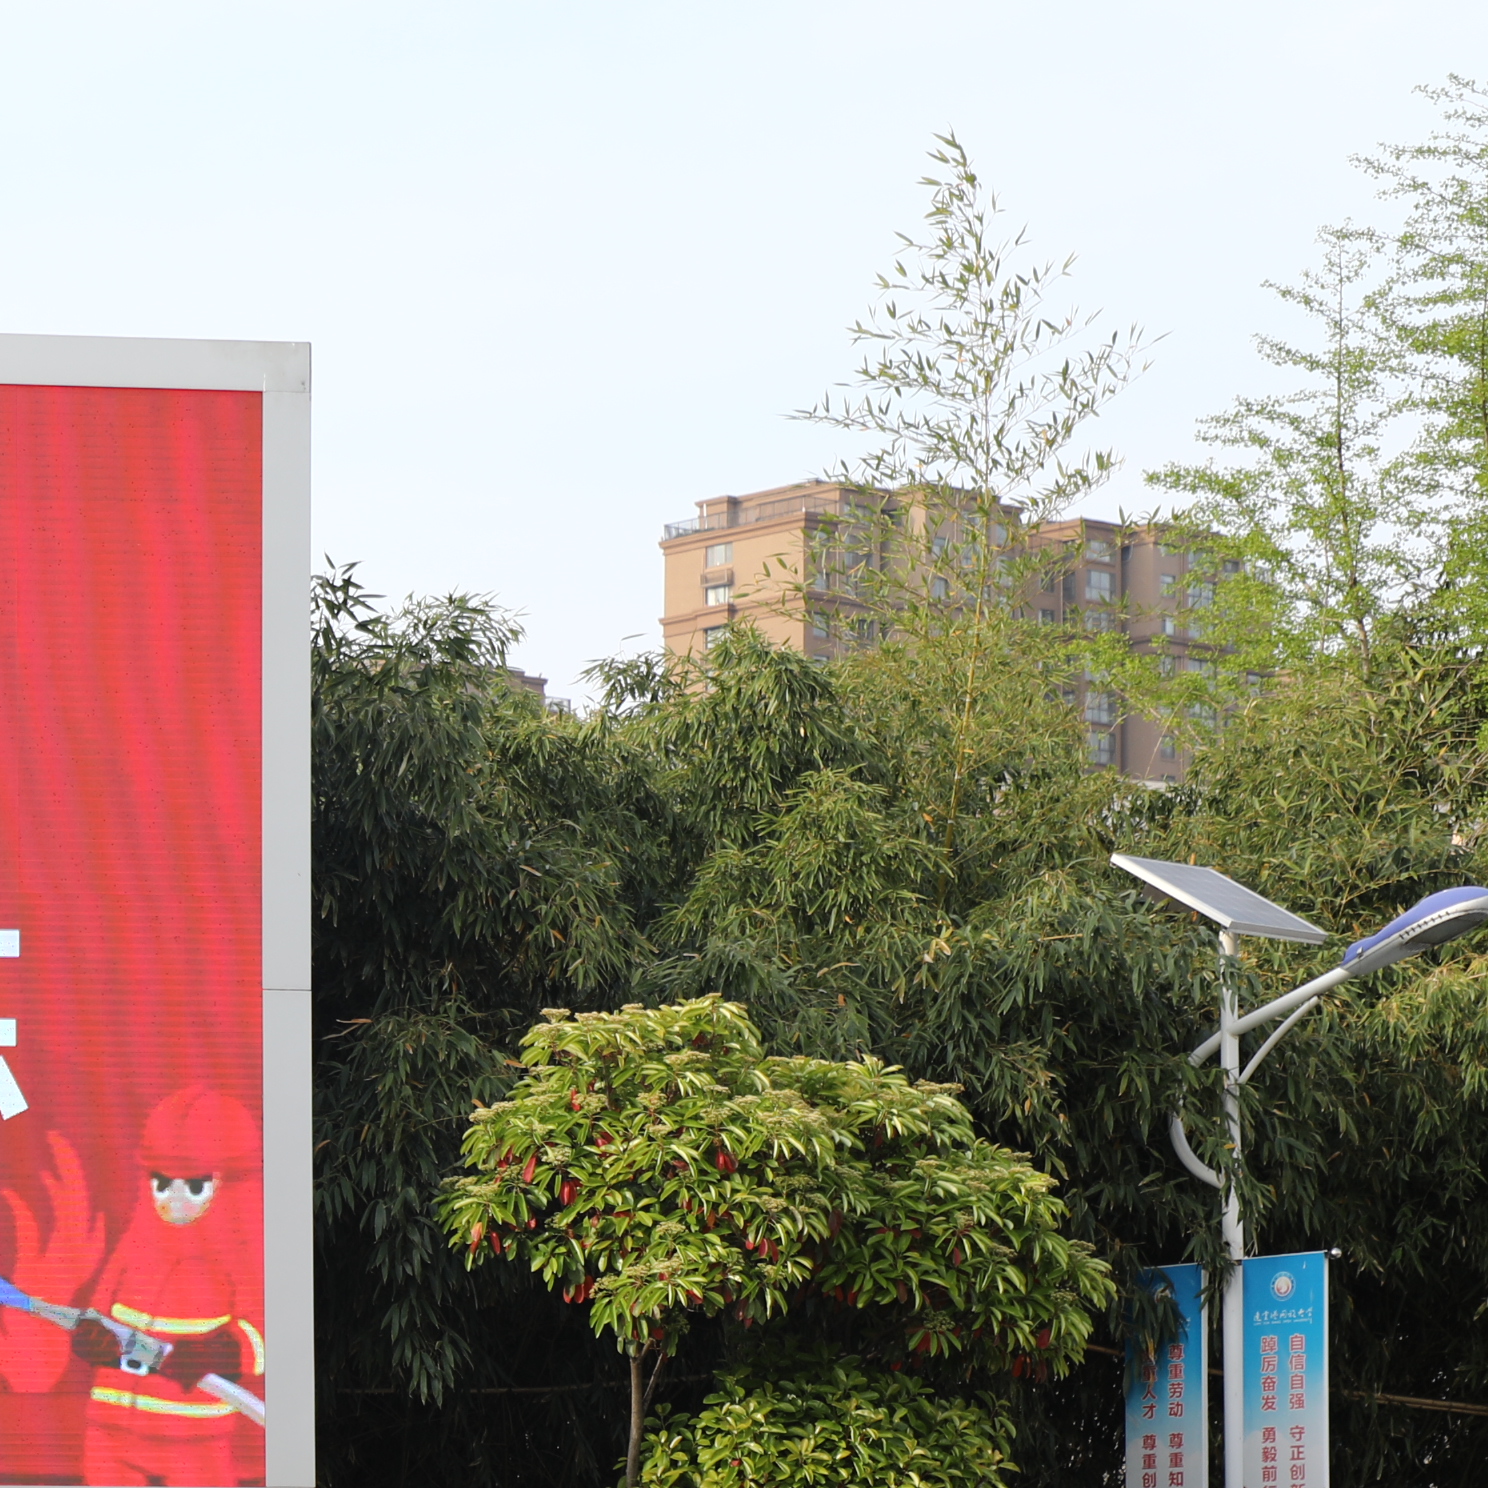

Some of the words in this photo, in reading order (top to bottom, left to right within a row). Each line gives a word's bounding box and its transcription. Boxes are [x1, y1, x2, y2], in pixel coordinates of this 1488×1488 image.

[1168, 1344, 1184, 1418] 尊重劳动
[1261, 1335, 1278, 1411] 踔厉奋发
[1289, 1334, 1305, 1410] 自信自强
